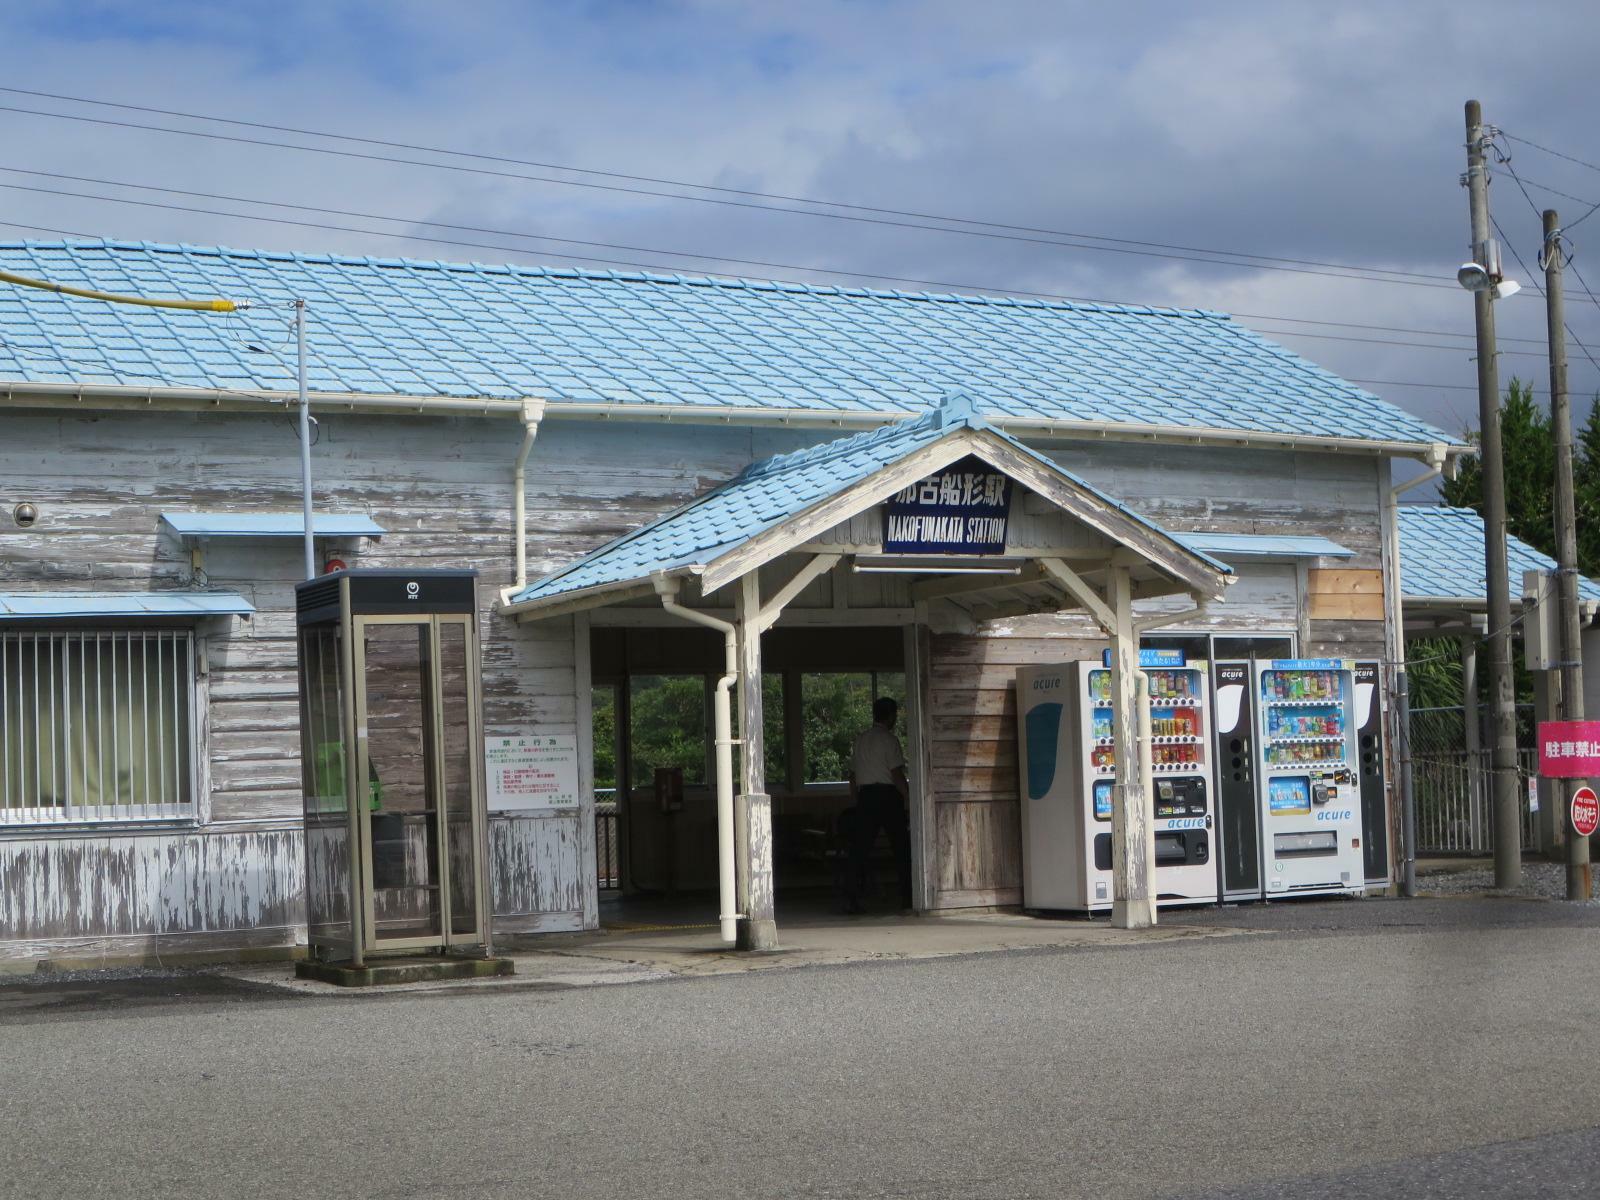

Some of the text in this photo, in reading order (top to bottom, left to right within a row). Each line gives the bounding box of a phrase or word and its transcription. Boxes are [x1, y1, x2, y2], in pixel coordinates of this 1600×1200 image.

[887, 515, 1006, 544] NAKOFUNAKATA STATION
[1033, 678, 1060, 689] acure
[1545, 741, 1600, 758] 駐車禁止
[1317, 811, 1351, 821] acure
[1167, 819, 1204, 829] acure
